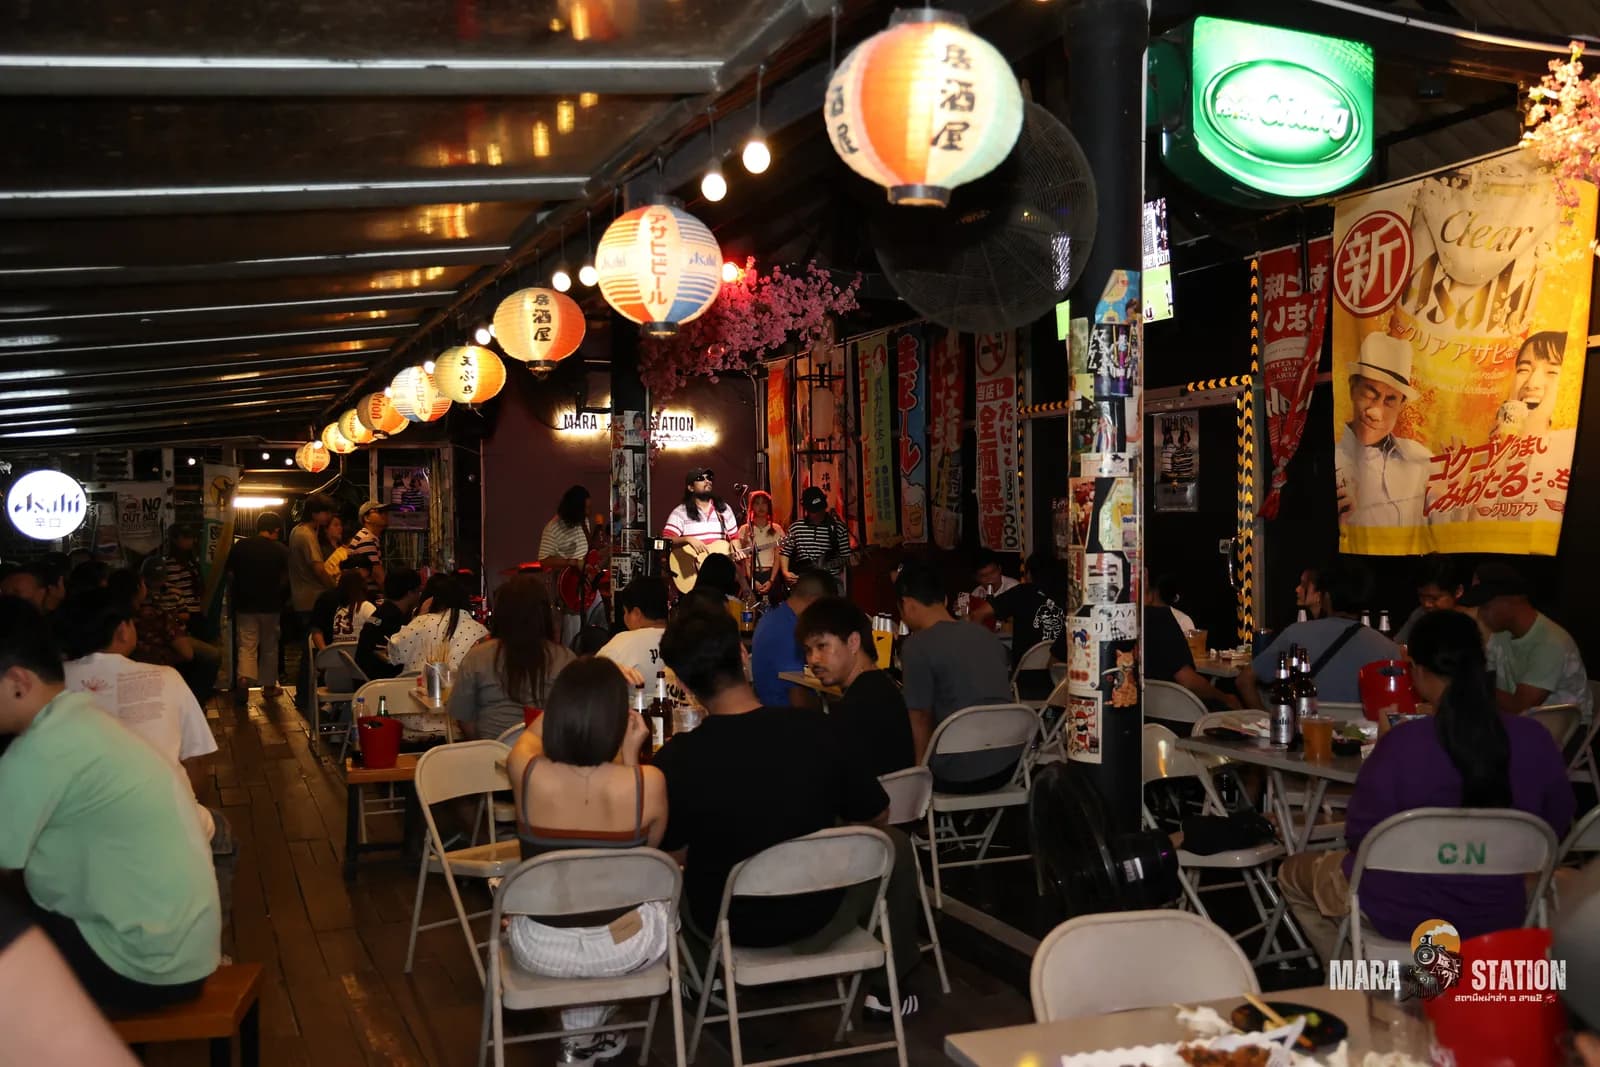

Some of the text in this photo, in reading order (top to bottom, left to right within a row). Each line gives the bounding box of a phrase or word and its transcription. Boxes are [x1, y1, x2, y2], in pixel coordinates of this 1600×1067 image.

[932, 43, 976, 151] 居酒屋
[1440, 210, 1533, 252] Clear
[649, 213, 668, 304] アサヒビール
[1342, 221, 1402, 306] 新
[533, 294, 553, 342] 居酒屋
[1453, 343, 1505, 365] アサヒ
[564, 414, 597, 430] MARA
[14, 493, 81, 514] Asahi
[142, 497, 161, 512] NO
